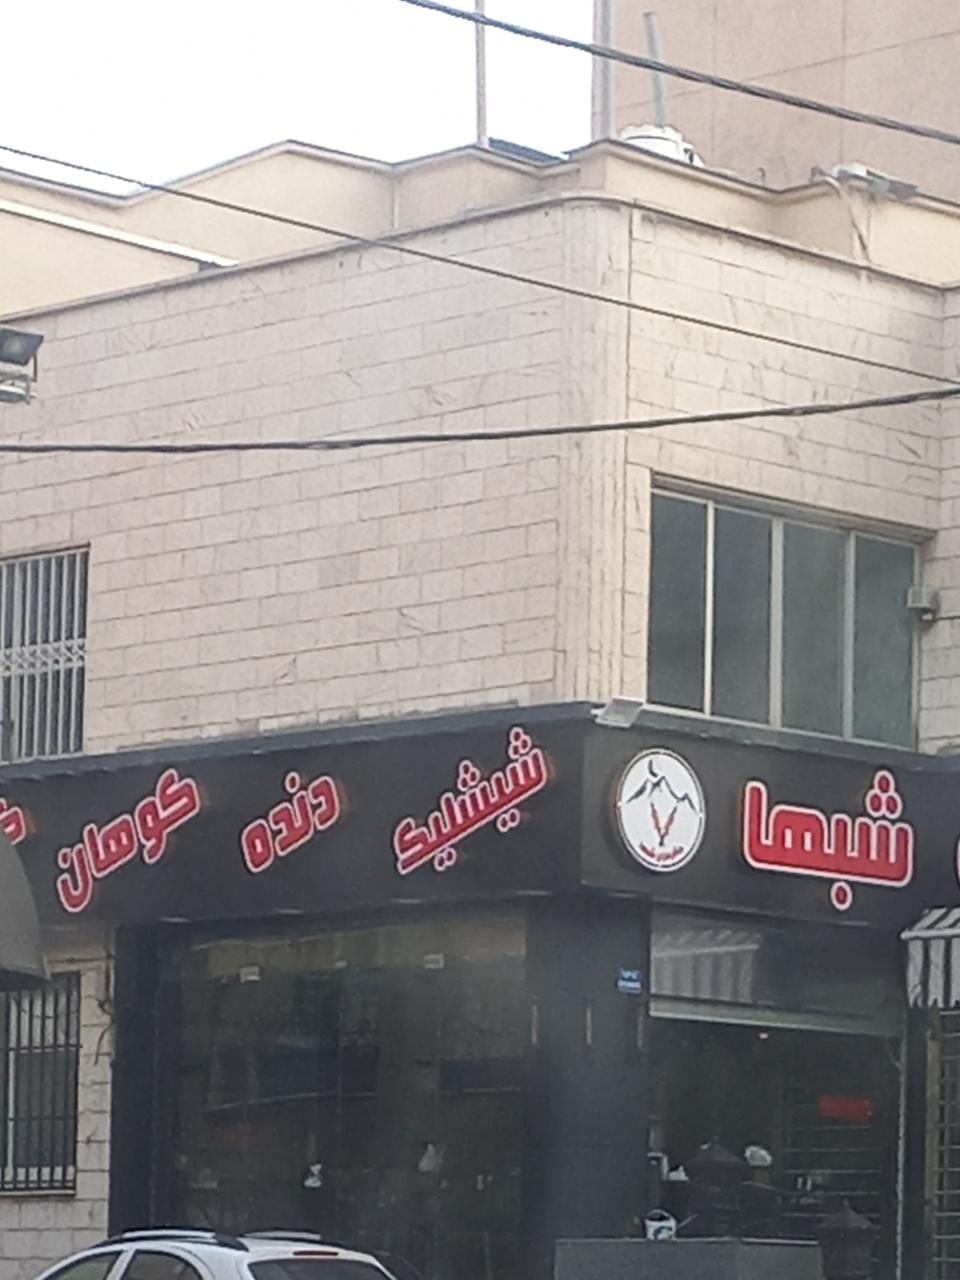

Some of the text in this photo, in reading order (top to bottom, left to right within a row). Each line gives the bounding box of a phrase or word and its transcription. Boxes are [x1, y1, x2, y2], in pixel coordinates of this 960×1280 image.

[56, 768, 201, 913] کوهان
[240, 771, 340, 873] دنده
[394, 726, 548, 874] شیشلیک
[743, 769, 914, 911] شبها
